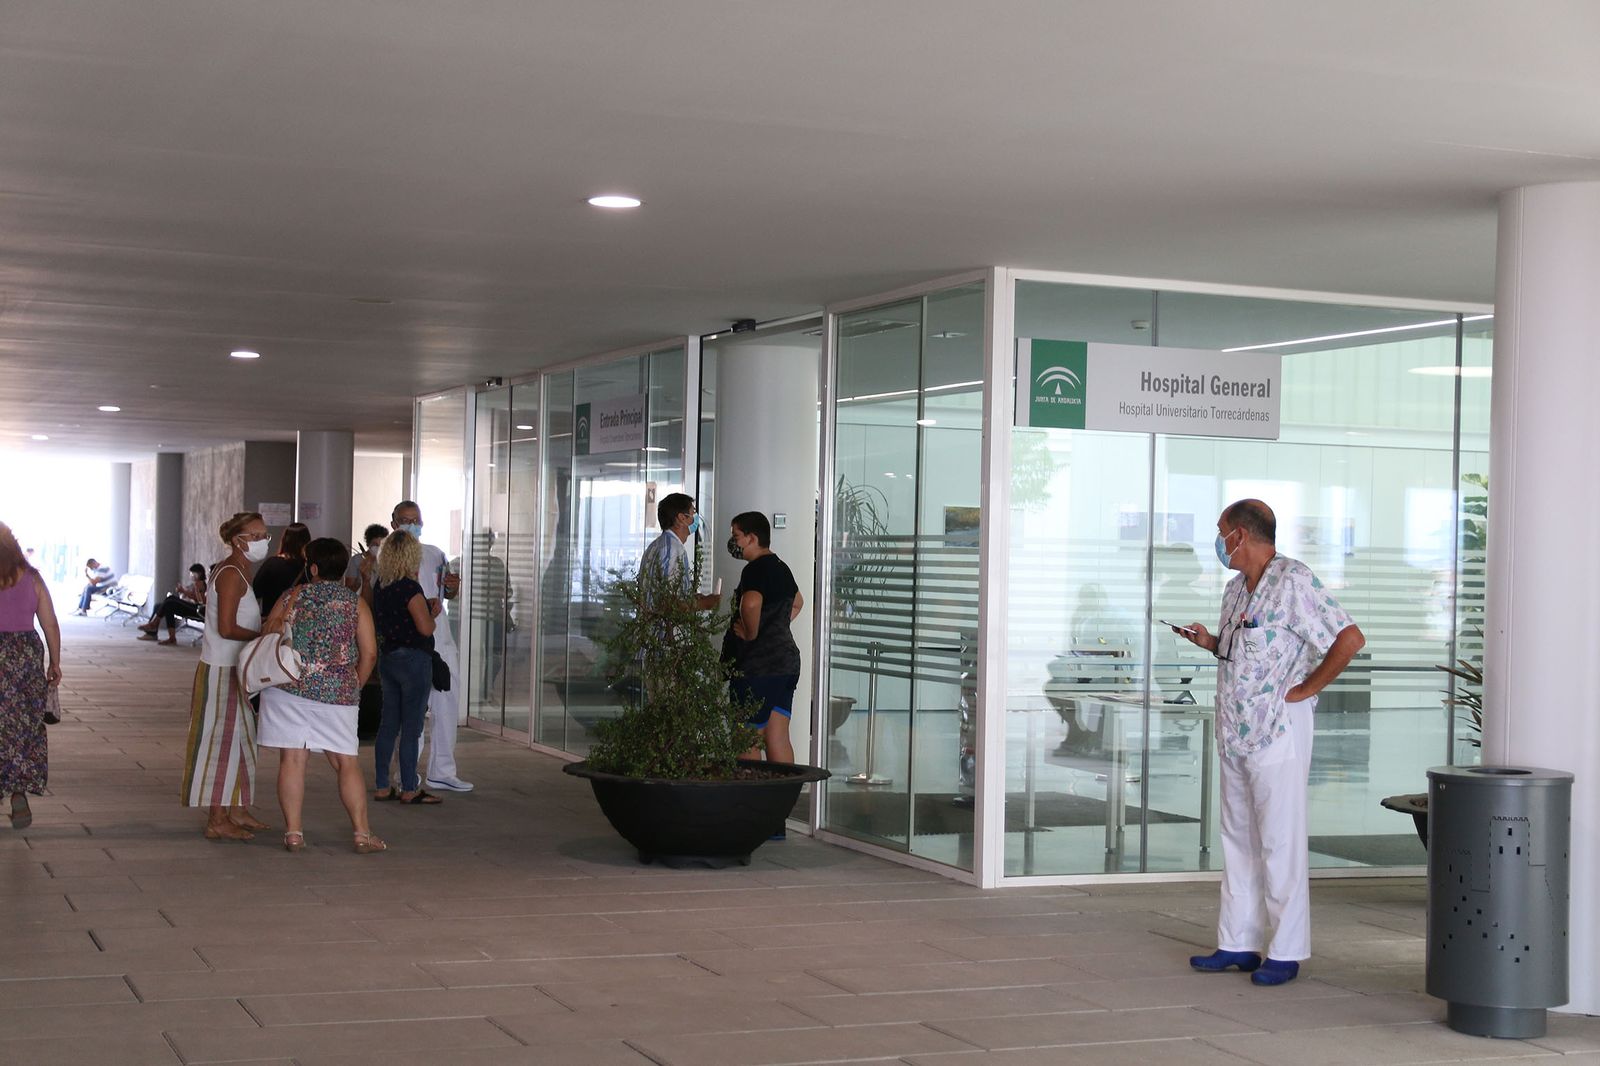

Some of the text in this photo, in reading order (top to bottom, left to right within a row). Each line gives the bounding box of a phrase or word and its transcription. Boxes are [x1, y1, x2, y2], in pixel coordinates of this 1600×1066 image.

[1141, 371, 1271, 398] Hospital General
[600, 407, 643, 429] Entrada Principal
[1119, 401, 1270, 422] Hospital Universitario Torrecárdenas
